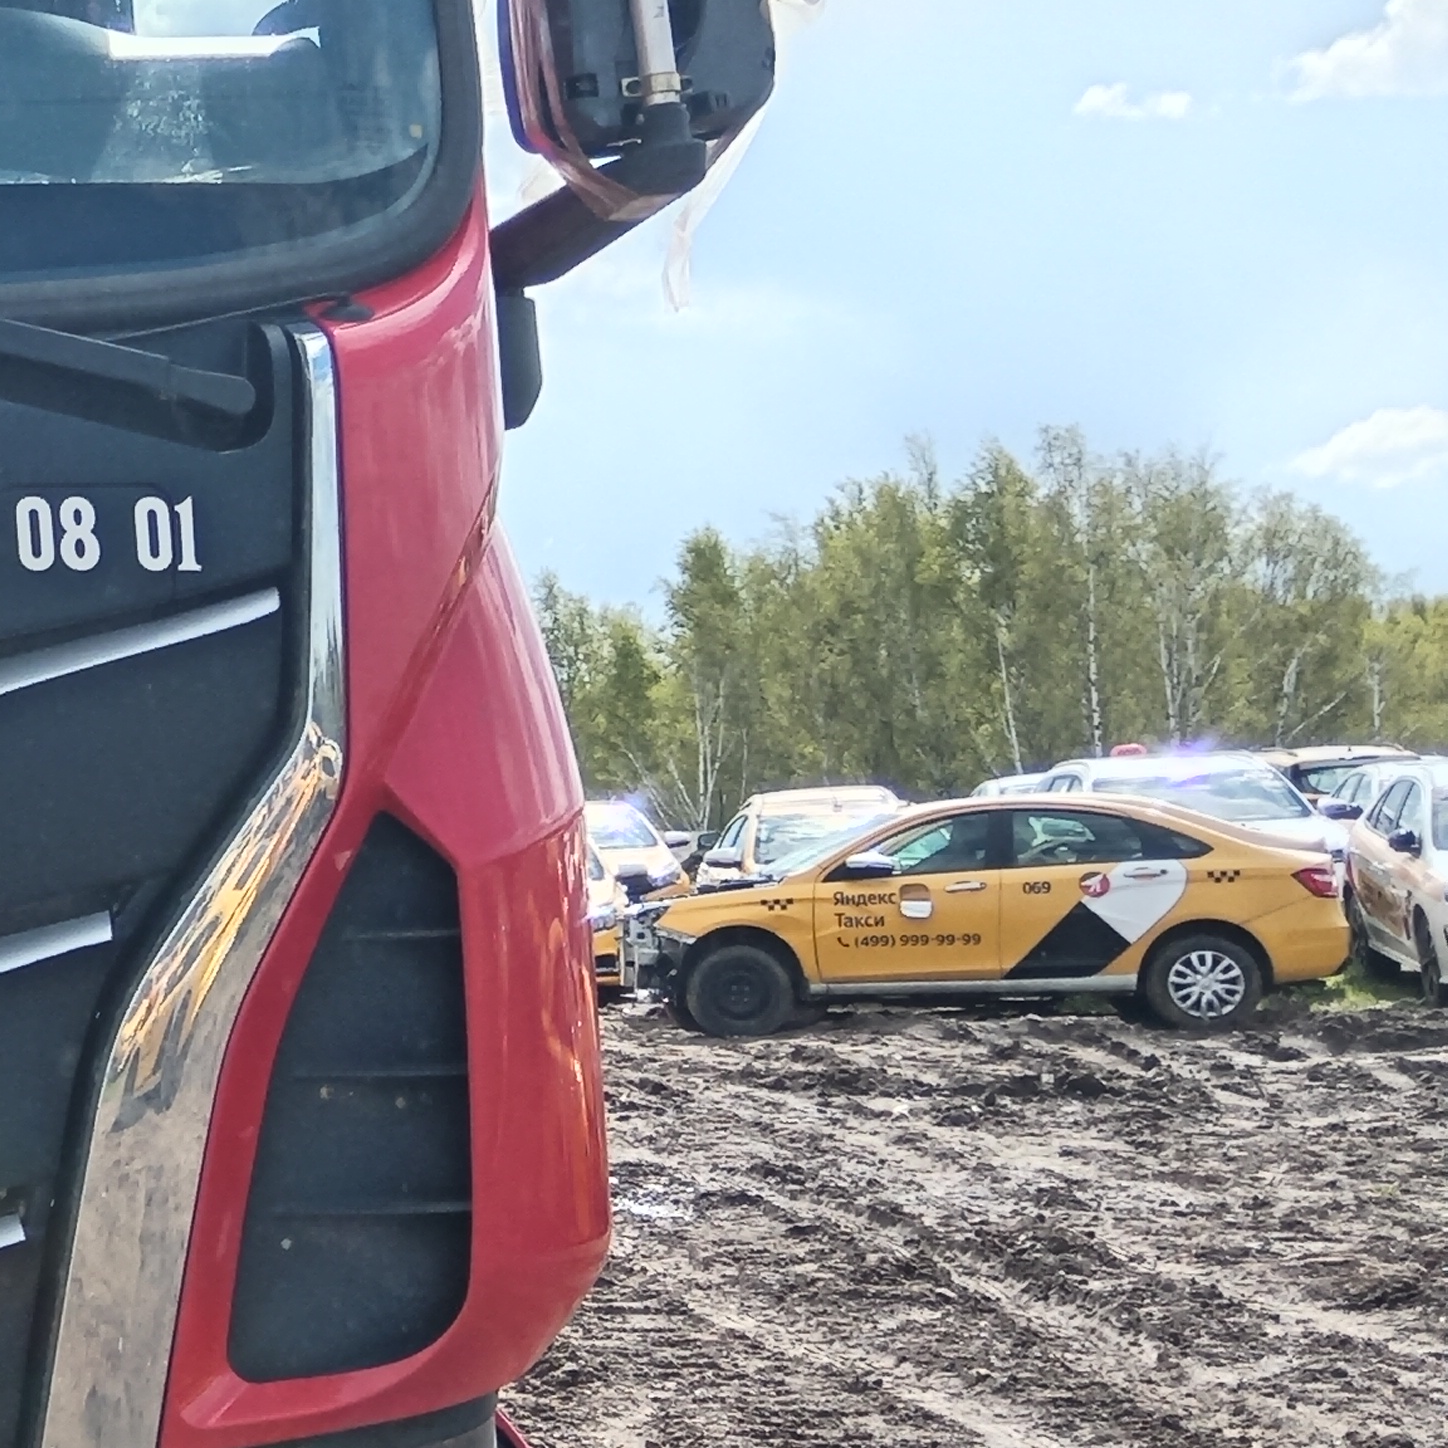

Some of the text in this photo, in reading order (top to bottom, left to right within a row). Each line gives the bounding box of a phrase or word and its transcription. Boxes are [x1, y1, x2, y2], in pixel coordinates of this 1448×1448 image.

[15, 495, 101, 573] 08
[134, 495, 203, 572] 01
[1022, 880, 1052, 894] 069
[833, 890, 897, 907] Яндекс
[834, 913, 885, 928] Такси
[854, 933, 982, 948] (499) 999-99-99
